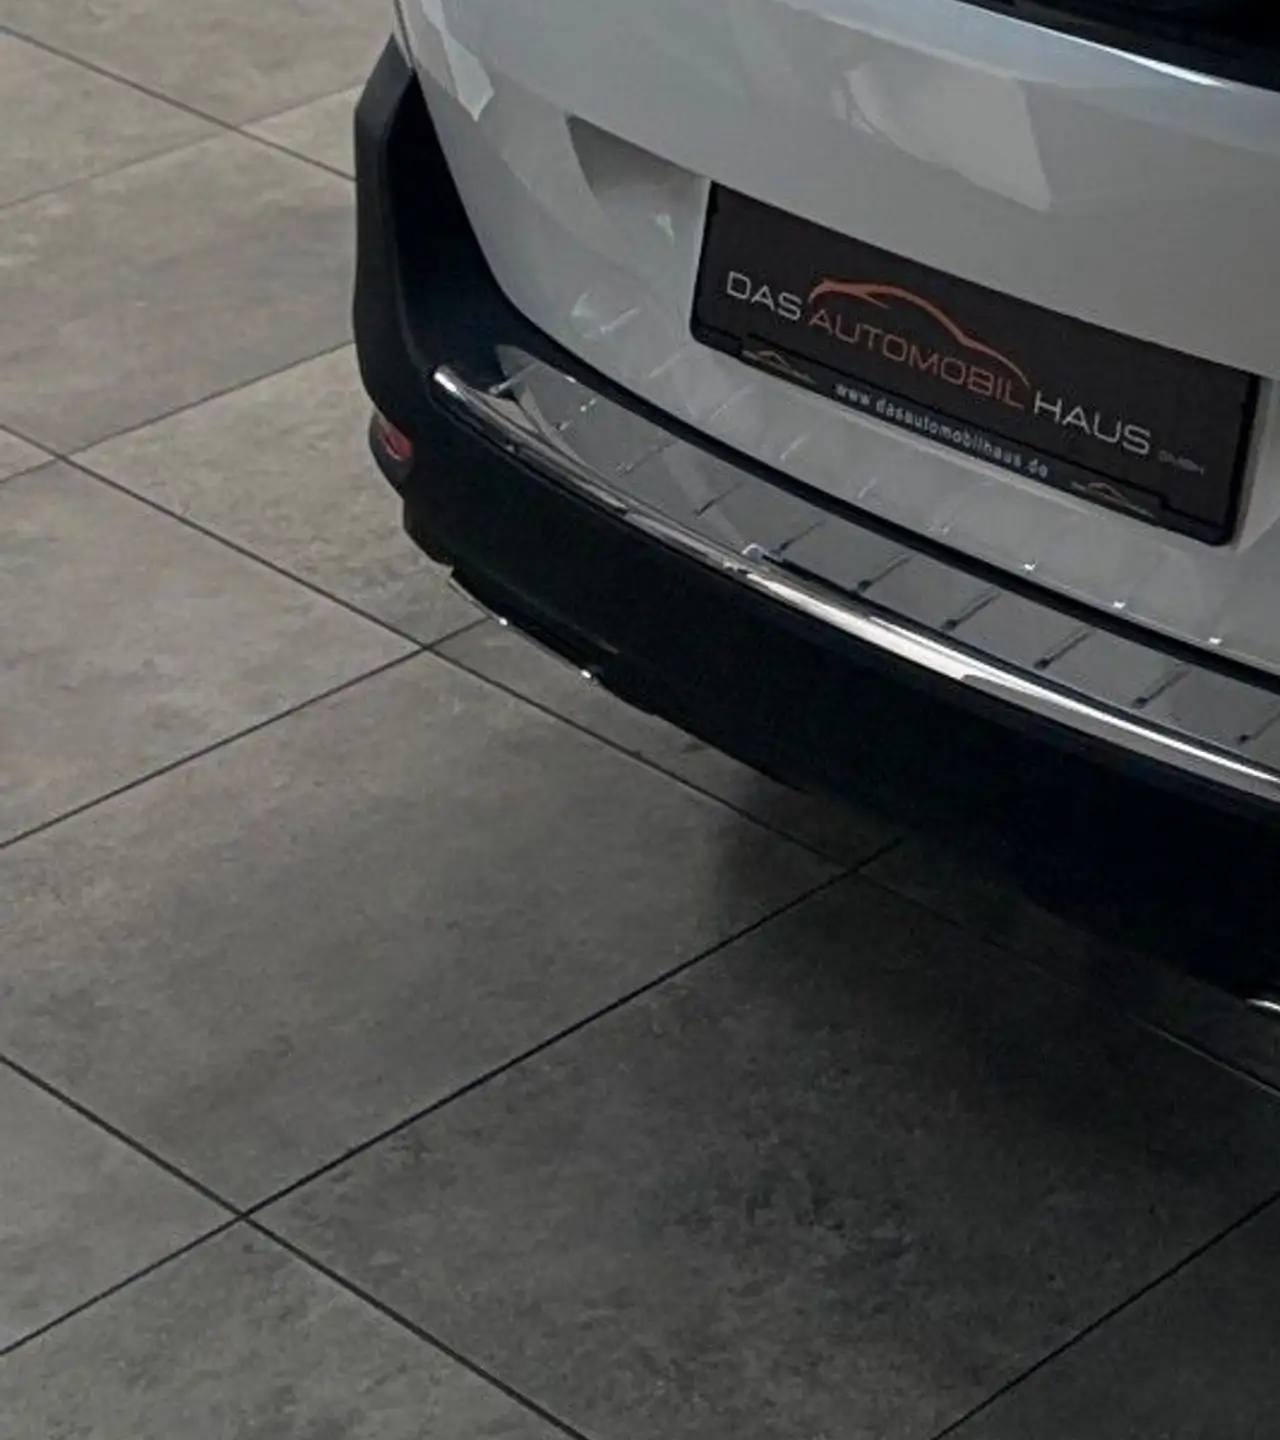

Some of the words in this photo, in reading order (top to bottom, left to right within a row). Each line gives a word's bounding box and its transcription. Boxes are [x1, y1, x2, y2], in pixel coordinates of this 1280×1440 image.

[725, 269, 802, 322] DAS
[807, 307, 1027, 410] AUTOMOBIL
[1033, 389, 1151, 454] HAUS
